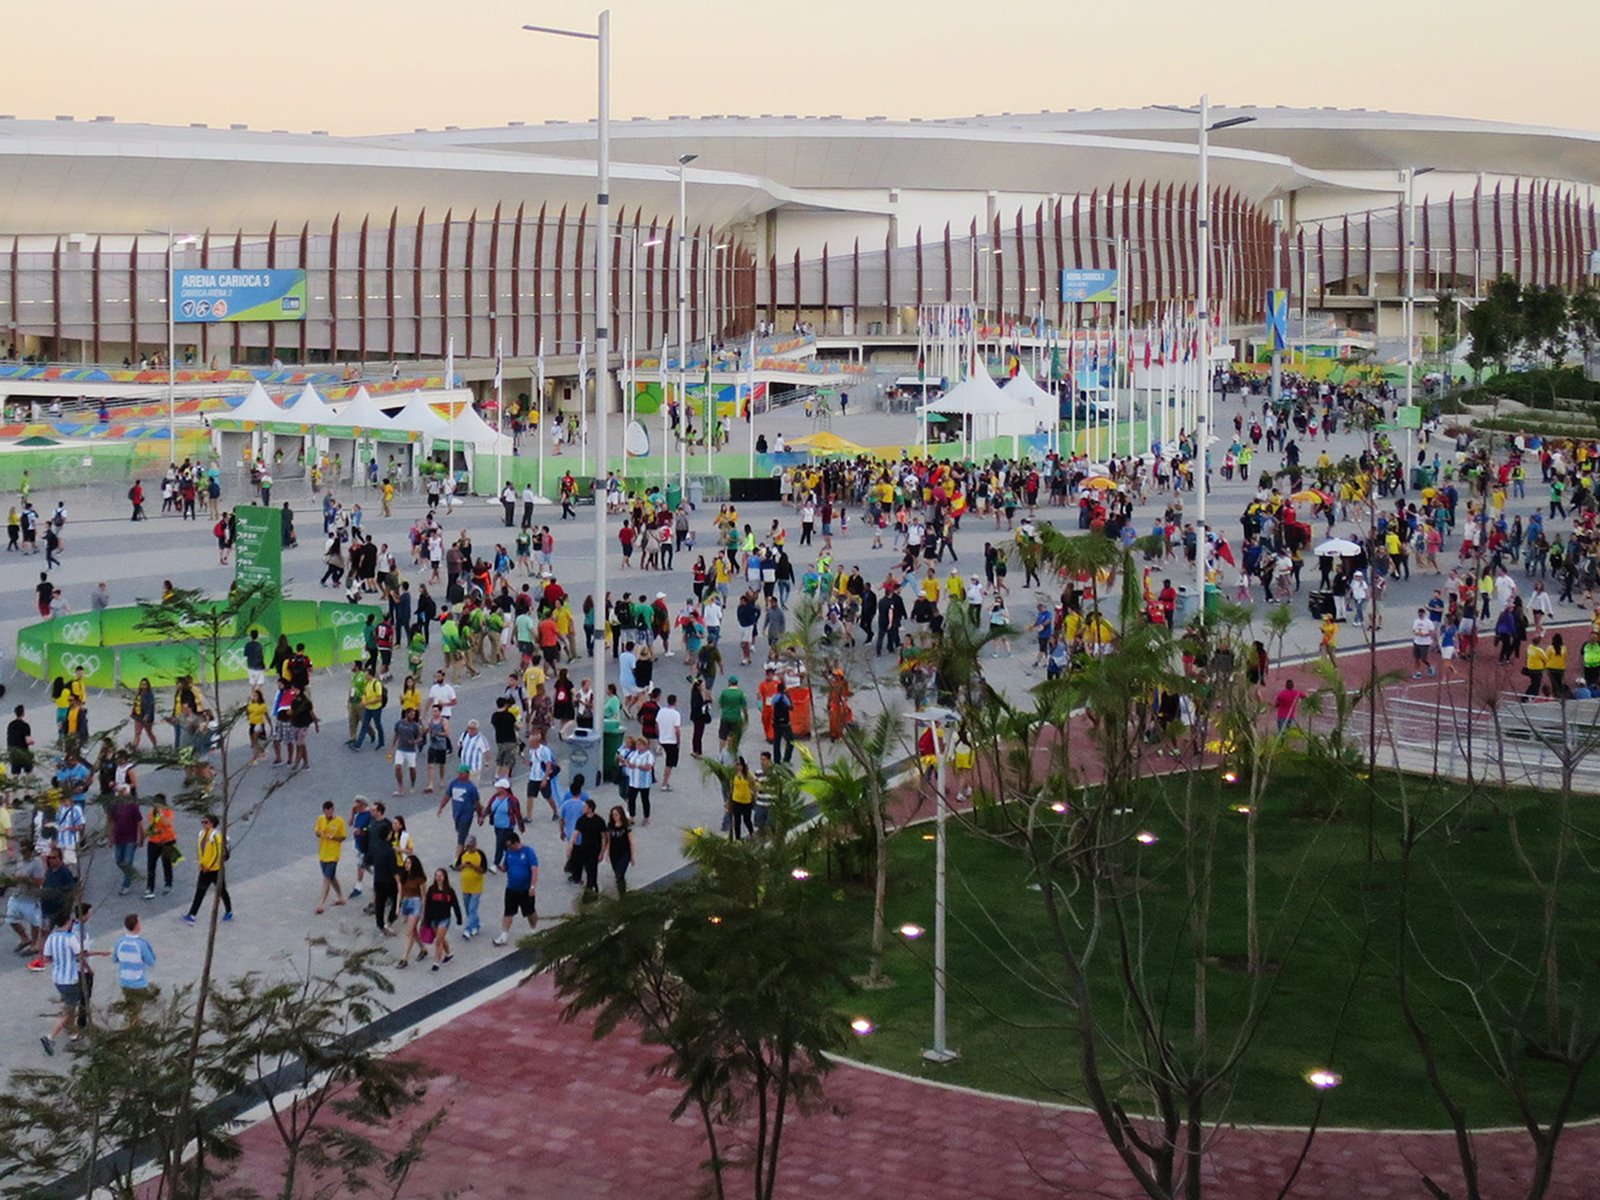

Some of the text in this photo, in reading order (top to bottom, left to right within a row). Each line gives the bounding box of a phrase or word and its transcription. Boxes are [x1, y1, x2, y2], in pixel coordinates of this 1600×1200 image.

[182, 275, 270, 287] ARENA CARIOCA 3
